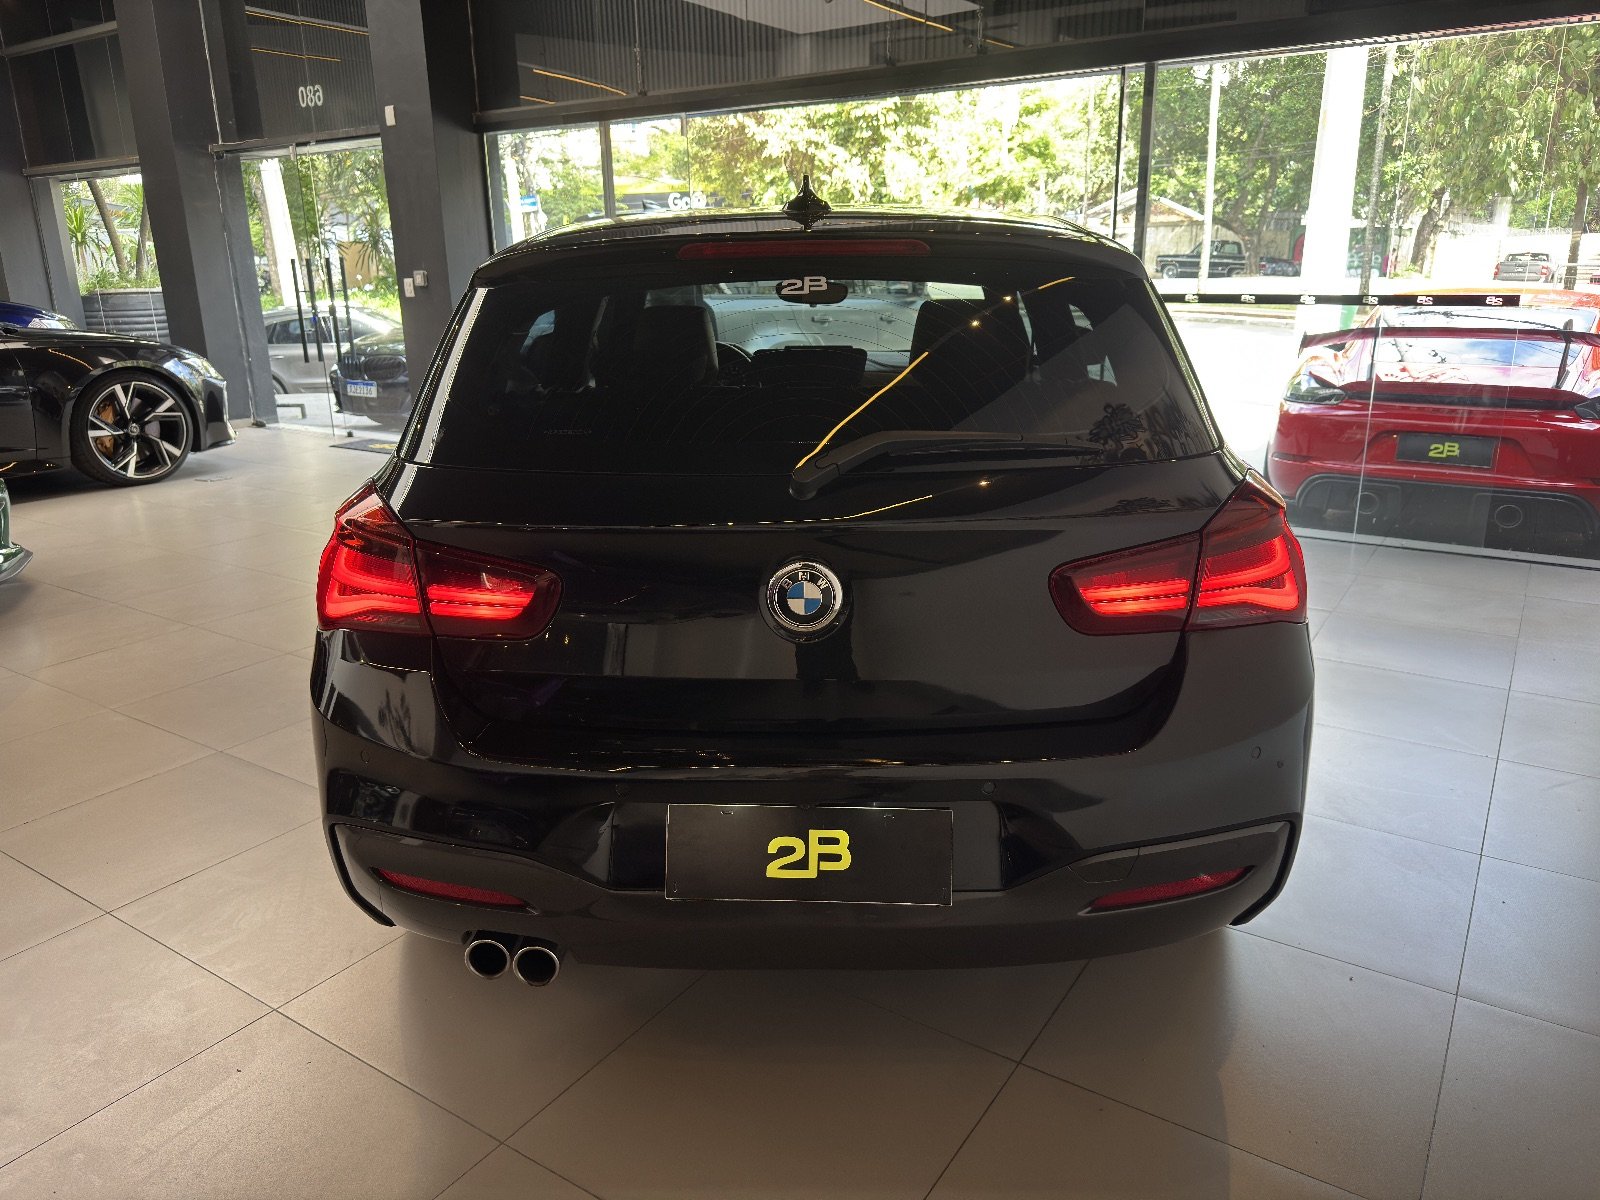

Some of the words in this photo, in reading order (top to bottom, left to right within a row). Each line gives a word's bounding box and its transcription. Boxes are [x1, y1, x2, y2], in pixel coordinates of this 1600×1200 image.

[780, 276, 828, 295] 2B
[1427, 442, 1460, 458] 2B
[780, 571, 829, 590] BMW
[765, 829, 852, 879] 2B
